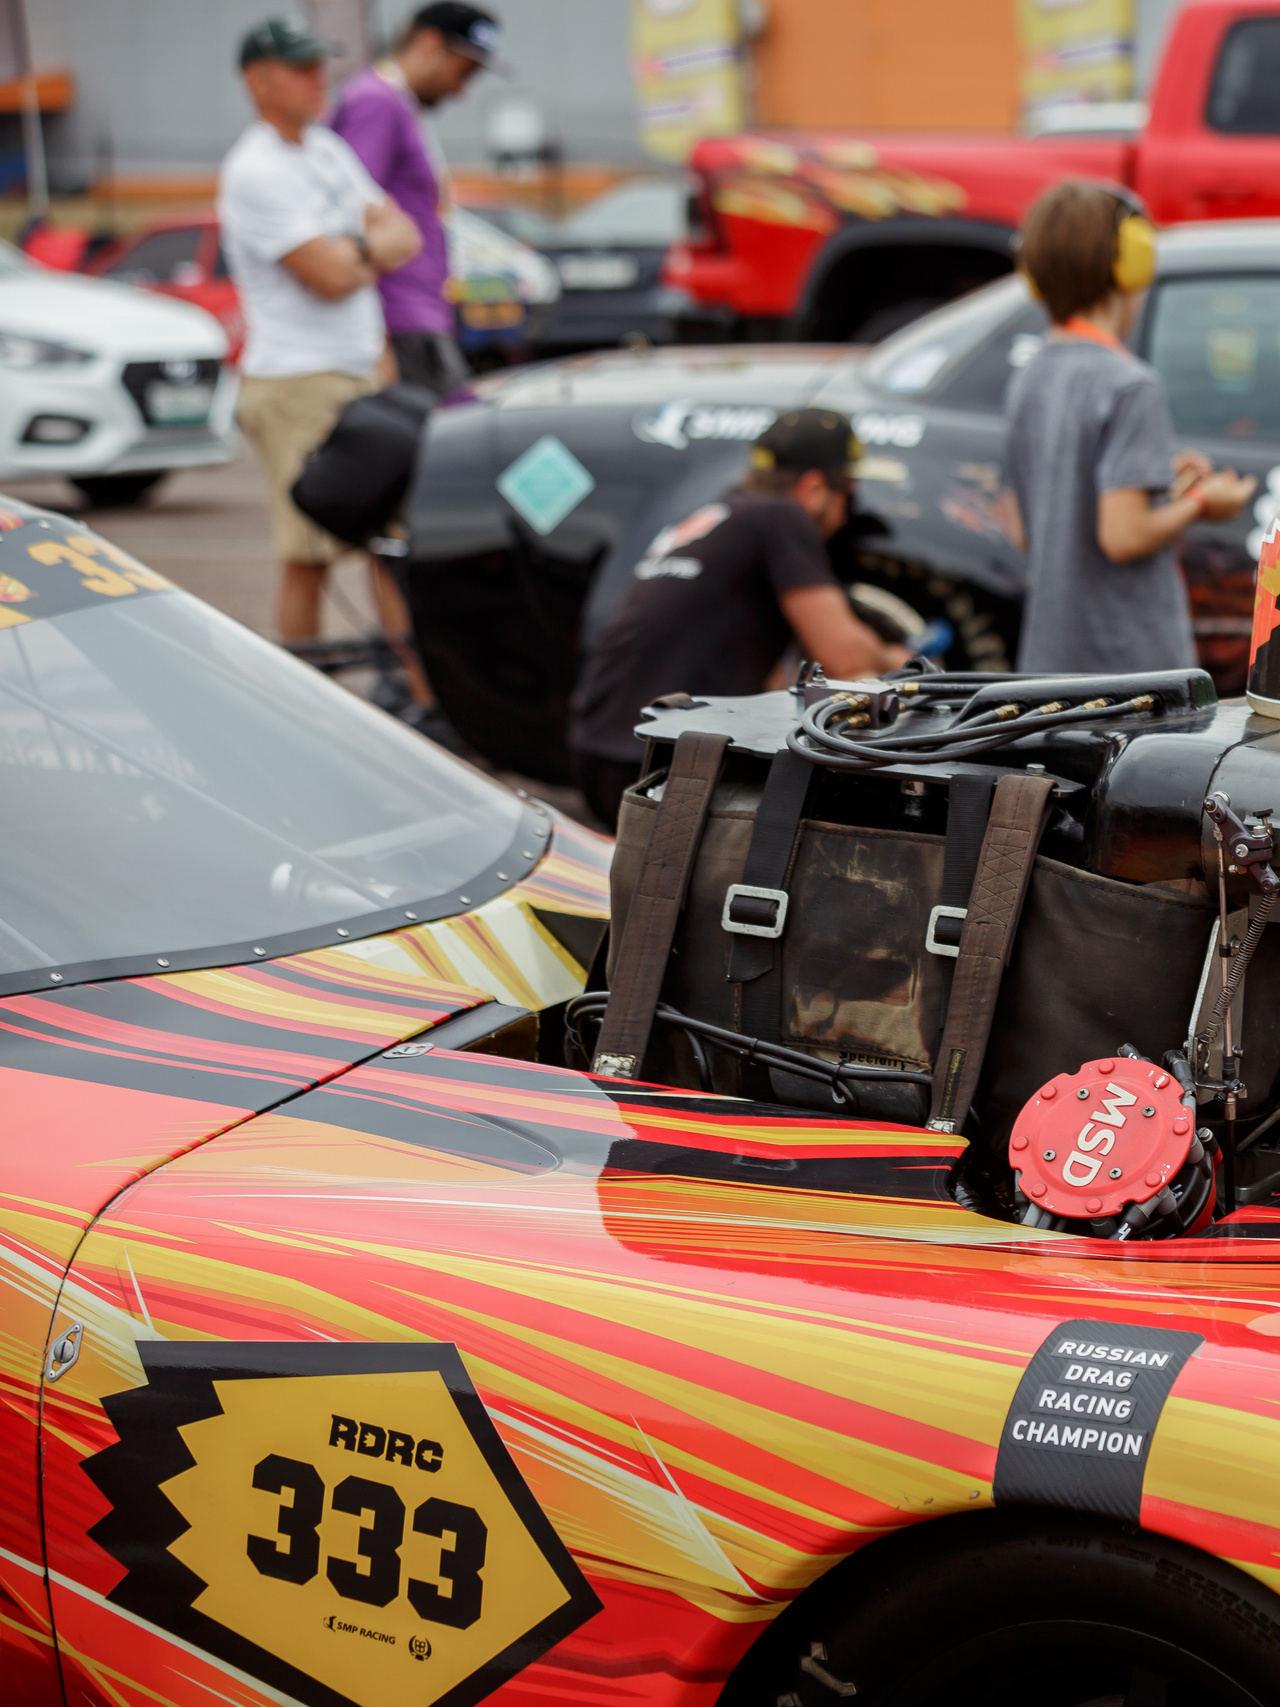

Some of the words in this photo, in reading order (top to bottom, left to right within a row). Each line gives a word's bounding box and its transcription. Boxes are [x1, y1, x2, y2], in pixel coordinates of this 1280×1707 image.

[1062, 1082, 1138, 1187] MSD
[1058, 1341, 1169, 1367] RUSSIAN
[1064, 1364, 1132, 1388] DRAG
[1038, 1389, 1131, 1418] RACING
[328, 1414, 444, 1474] RDRC
[1012, 1419, 1143, 1456] CHAMPION
[246, 1453, 489, 1630] 333
[336, 1621, 359, 1634] SMP
[359, 1627, 396, 1645] RACING
